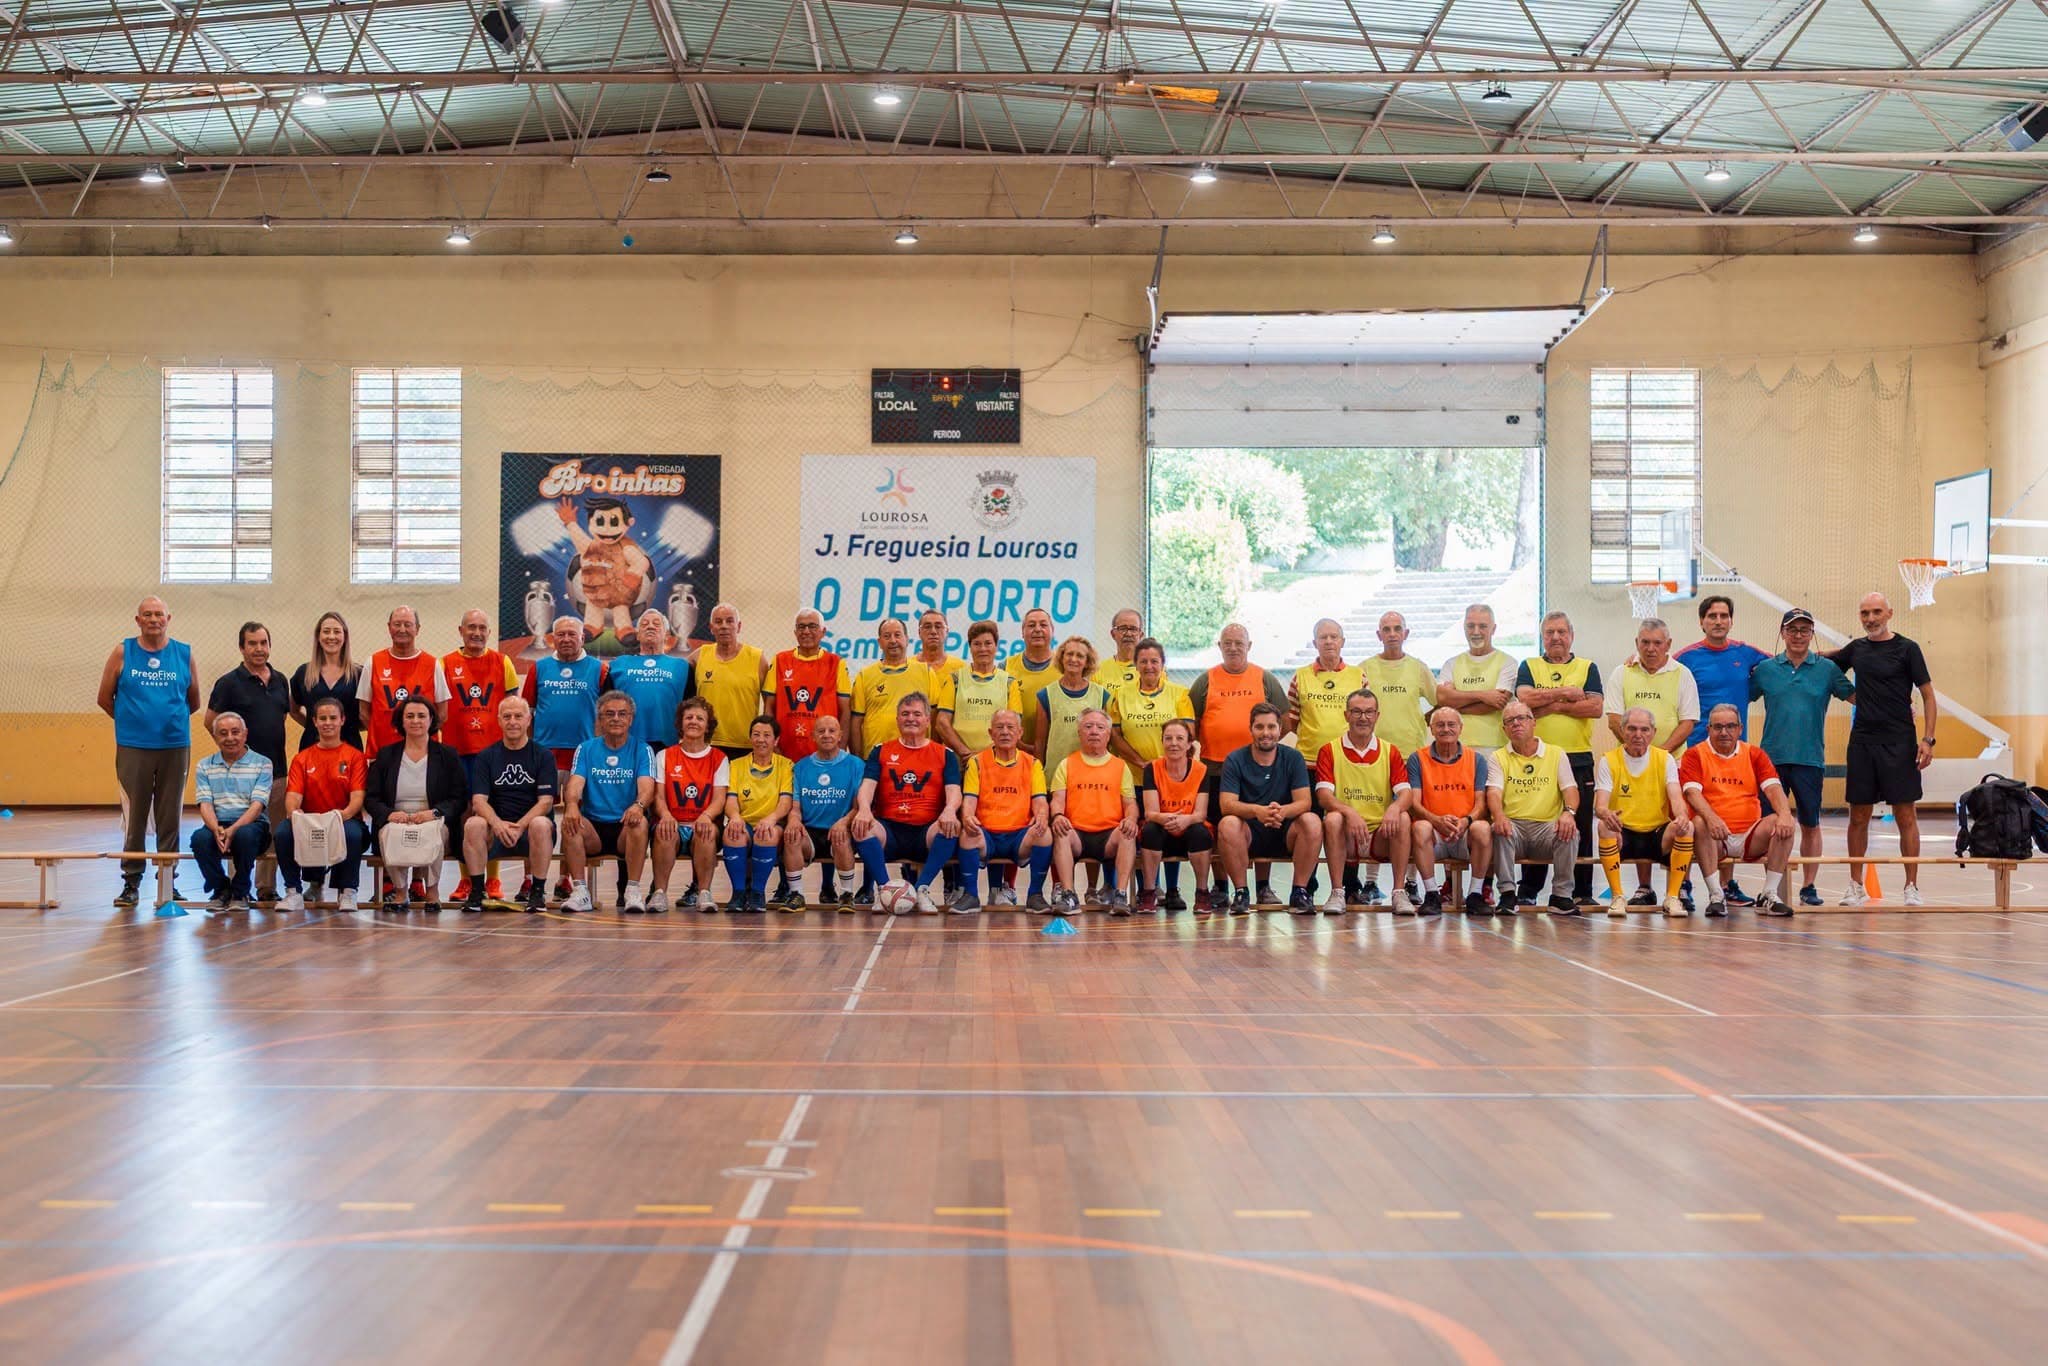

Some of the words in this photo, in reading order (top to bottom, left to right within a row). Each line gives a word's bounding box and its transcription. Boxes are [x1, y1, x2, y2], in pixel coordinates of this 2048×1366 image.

[879, 400, 918, 411] LOCAL
[975, 401, 1015, 411] VISITANTE
[933, 430, 961, 439] PERIODO
[648, 465, 686, 474] VERGADA
[540, 460, 686, 498] Broinhas
[861, 512, 929, 522] LOUROSA
[815, 534, 839, 557] J.
[847, 534, 970, 563] Freguesia
[977, 536, 1079, 559] Lourosa
[813, 577, 841, 622] O
[859, 578, 1080, 624] DESPORTO
[1711, 777, 1744, 785] KIPSTA
[1077, 783, 1109, 791] KIPSTA
